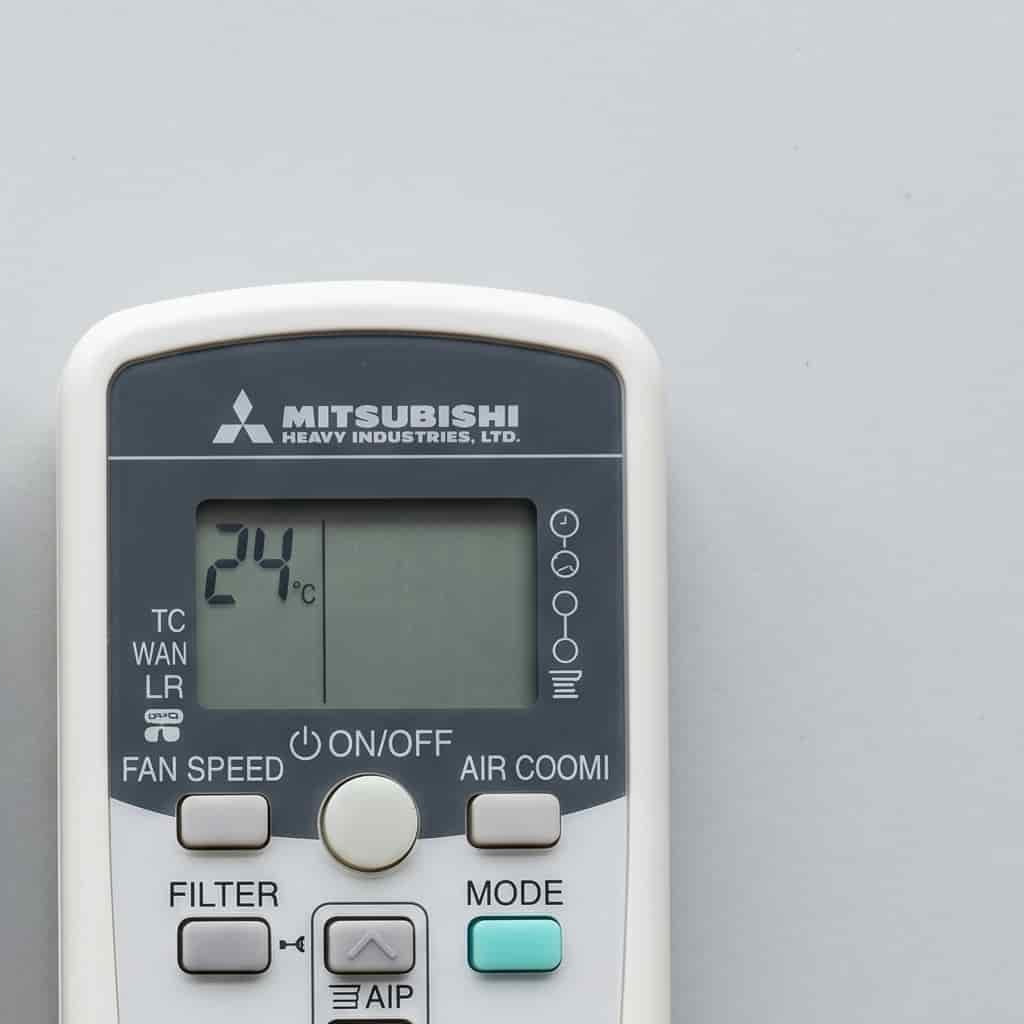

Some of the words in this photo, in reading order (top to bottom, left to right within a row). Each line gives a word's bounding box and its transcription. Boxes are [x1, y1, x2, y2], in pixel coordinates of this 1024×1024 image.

[281, 404, 520, 430] MITSUBISHI
[281, 431, 349, 444] HEAVY
[352, 431, 477, 446] INDUSTRIES,
[481, 431, 521, 444] LTD.
[151, 608, 186, 633] TC
[132, 641, 188, 666] WAN
[145, 674, 184, 700] LR
[328, 729, 454, 759] ON/OFF
[122, 757, 178, 783] FAN
[187, 756, 285, 783] SPEED
[460, 755, 507, 781] AIR
[515, 754, 610, 782] COOMI
[169, 881, 280, 908] FILTER
[467, 879, 564, 907] MODE
[365, 984, 414, 1010] AIP
